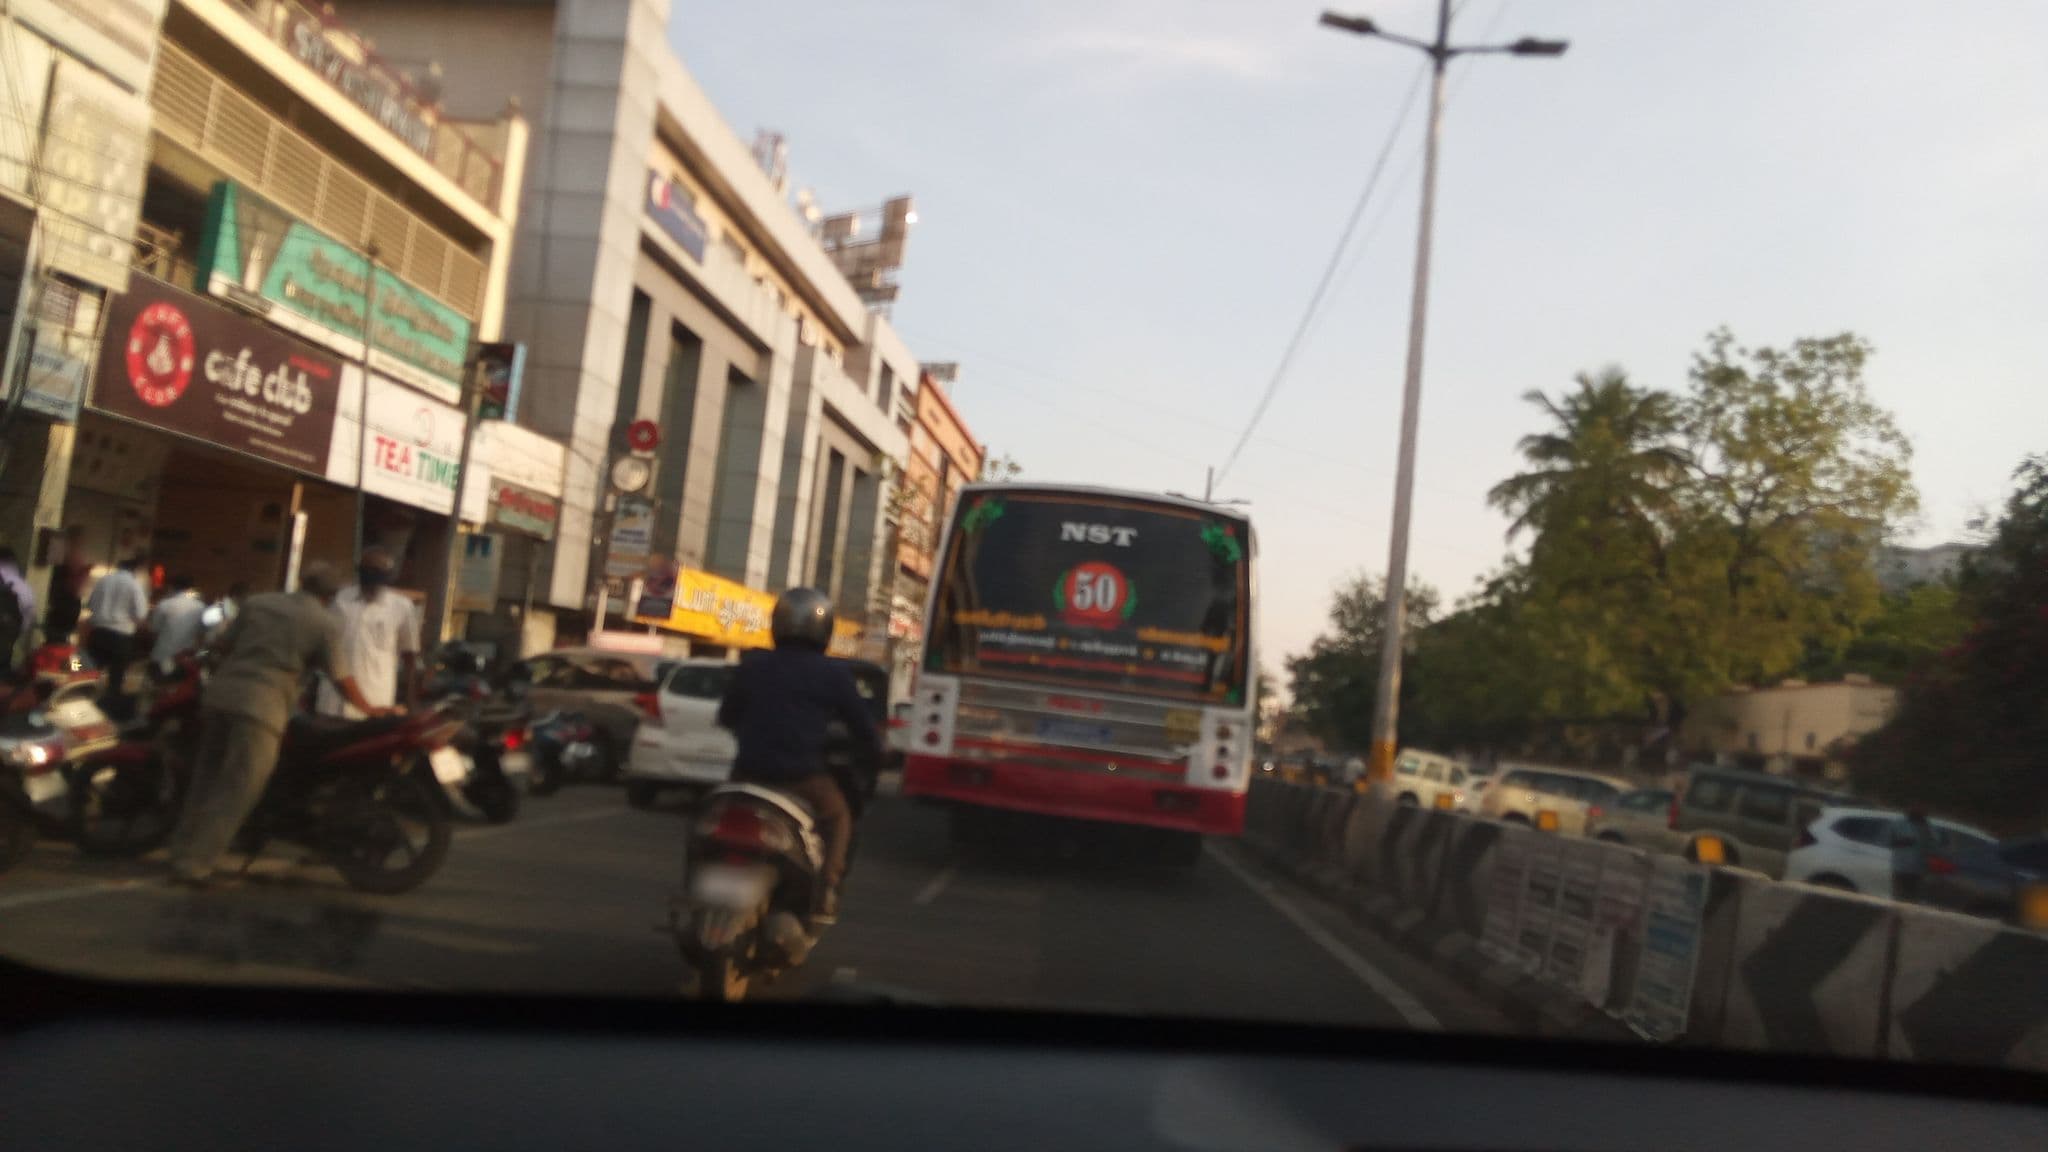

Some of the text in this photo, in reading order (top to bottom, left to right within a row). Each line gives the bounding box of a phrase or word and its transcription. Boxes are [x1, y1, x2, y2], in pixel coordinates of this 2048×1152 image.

[263, 364, 322, 414] club
[373, 435, 461, 492] TEA TIME
[1060, 521, 1139, 547] NST
[1073, 570, 1117, 613] 50
